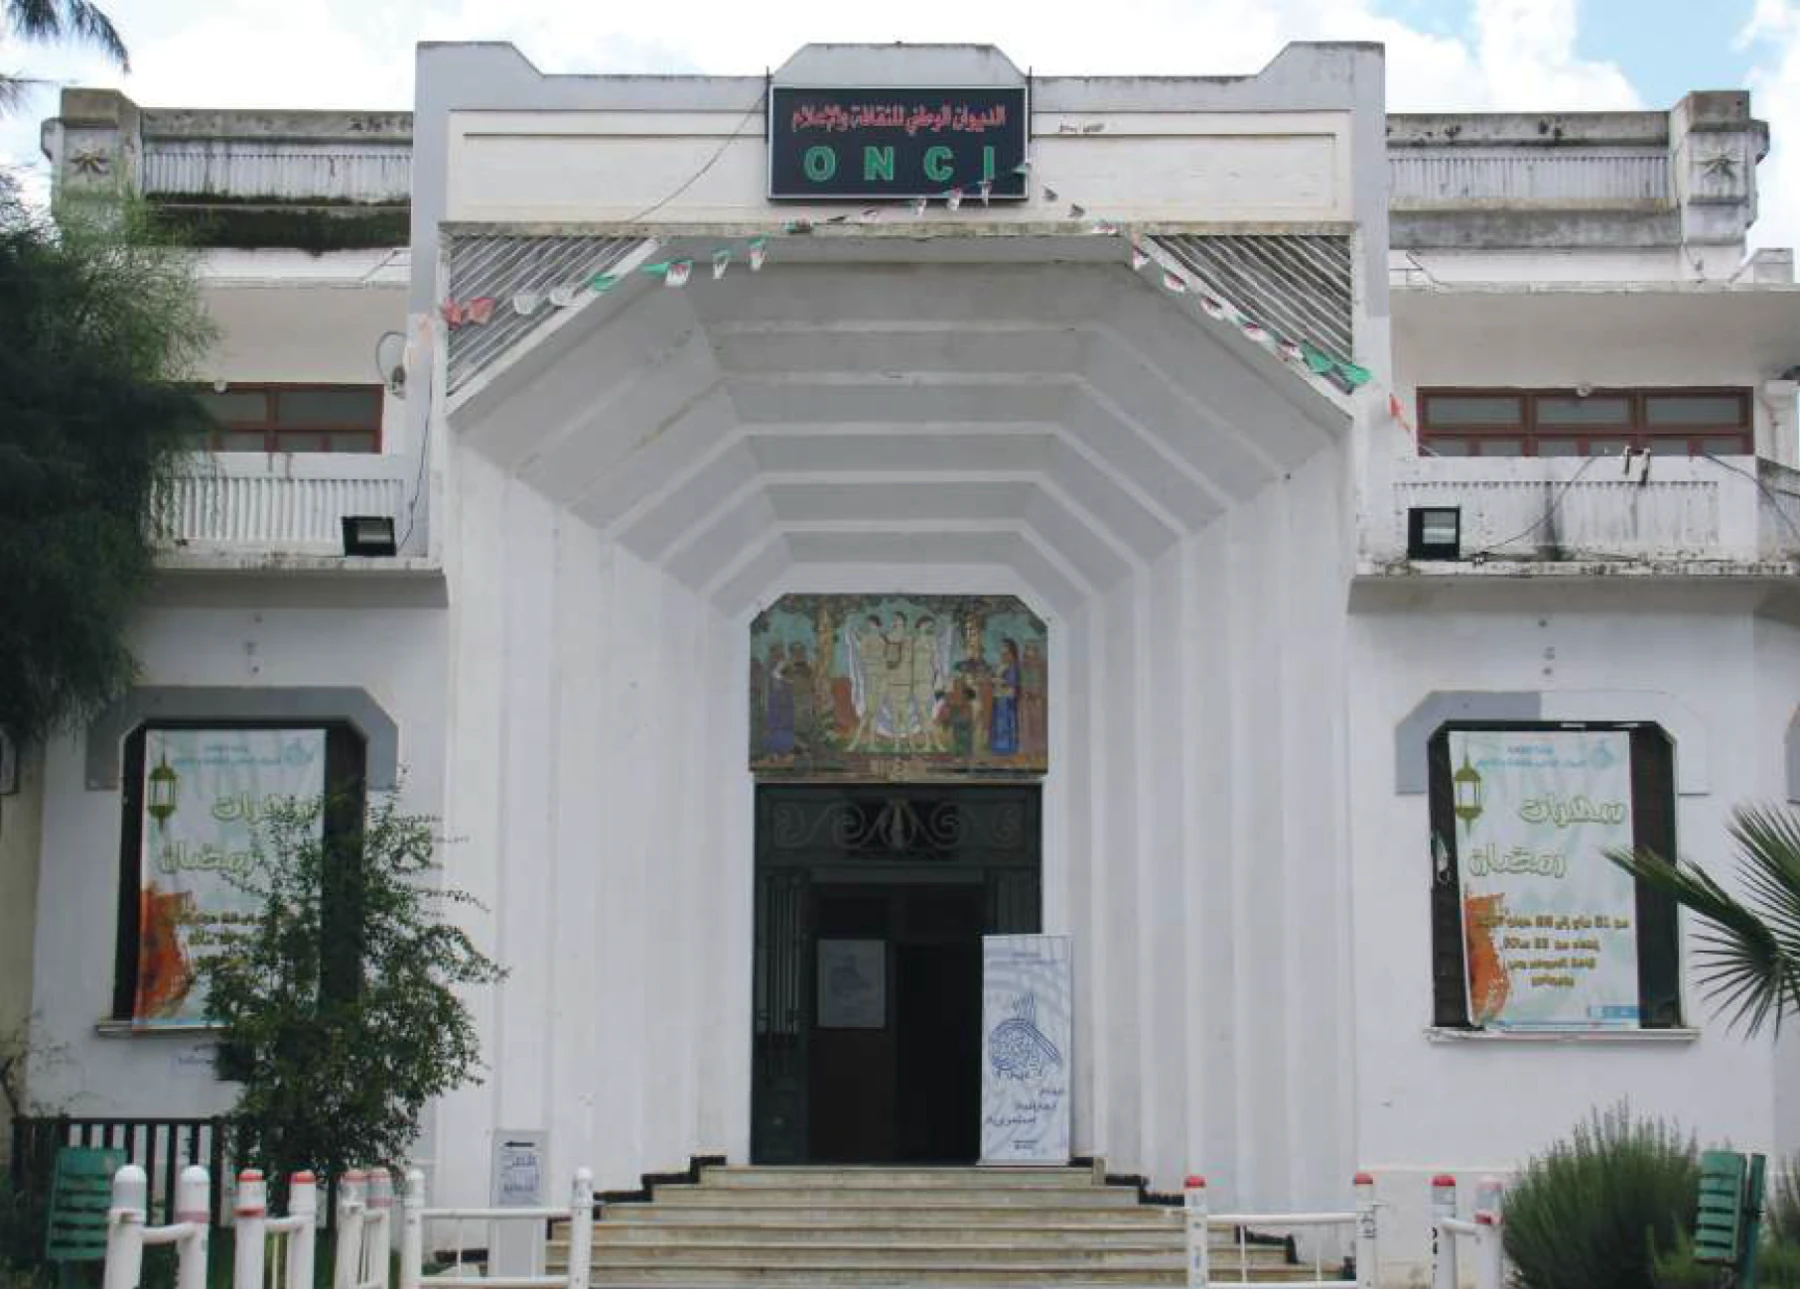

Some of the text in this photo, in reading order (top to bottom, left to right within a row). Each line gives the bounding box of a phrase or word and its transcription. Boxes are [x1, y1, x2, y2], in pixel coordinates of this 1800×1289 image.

[905, 104, 951, 136] الوطني
[953, 104, 1006, 132] الديوان
[804, 146, 995, 180] ONCI
